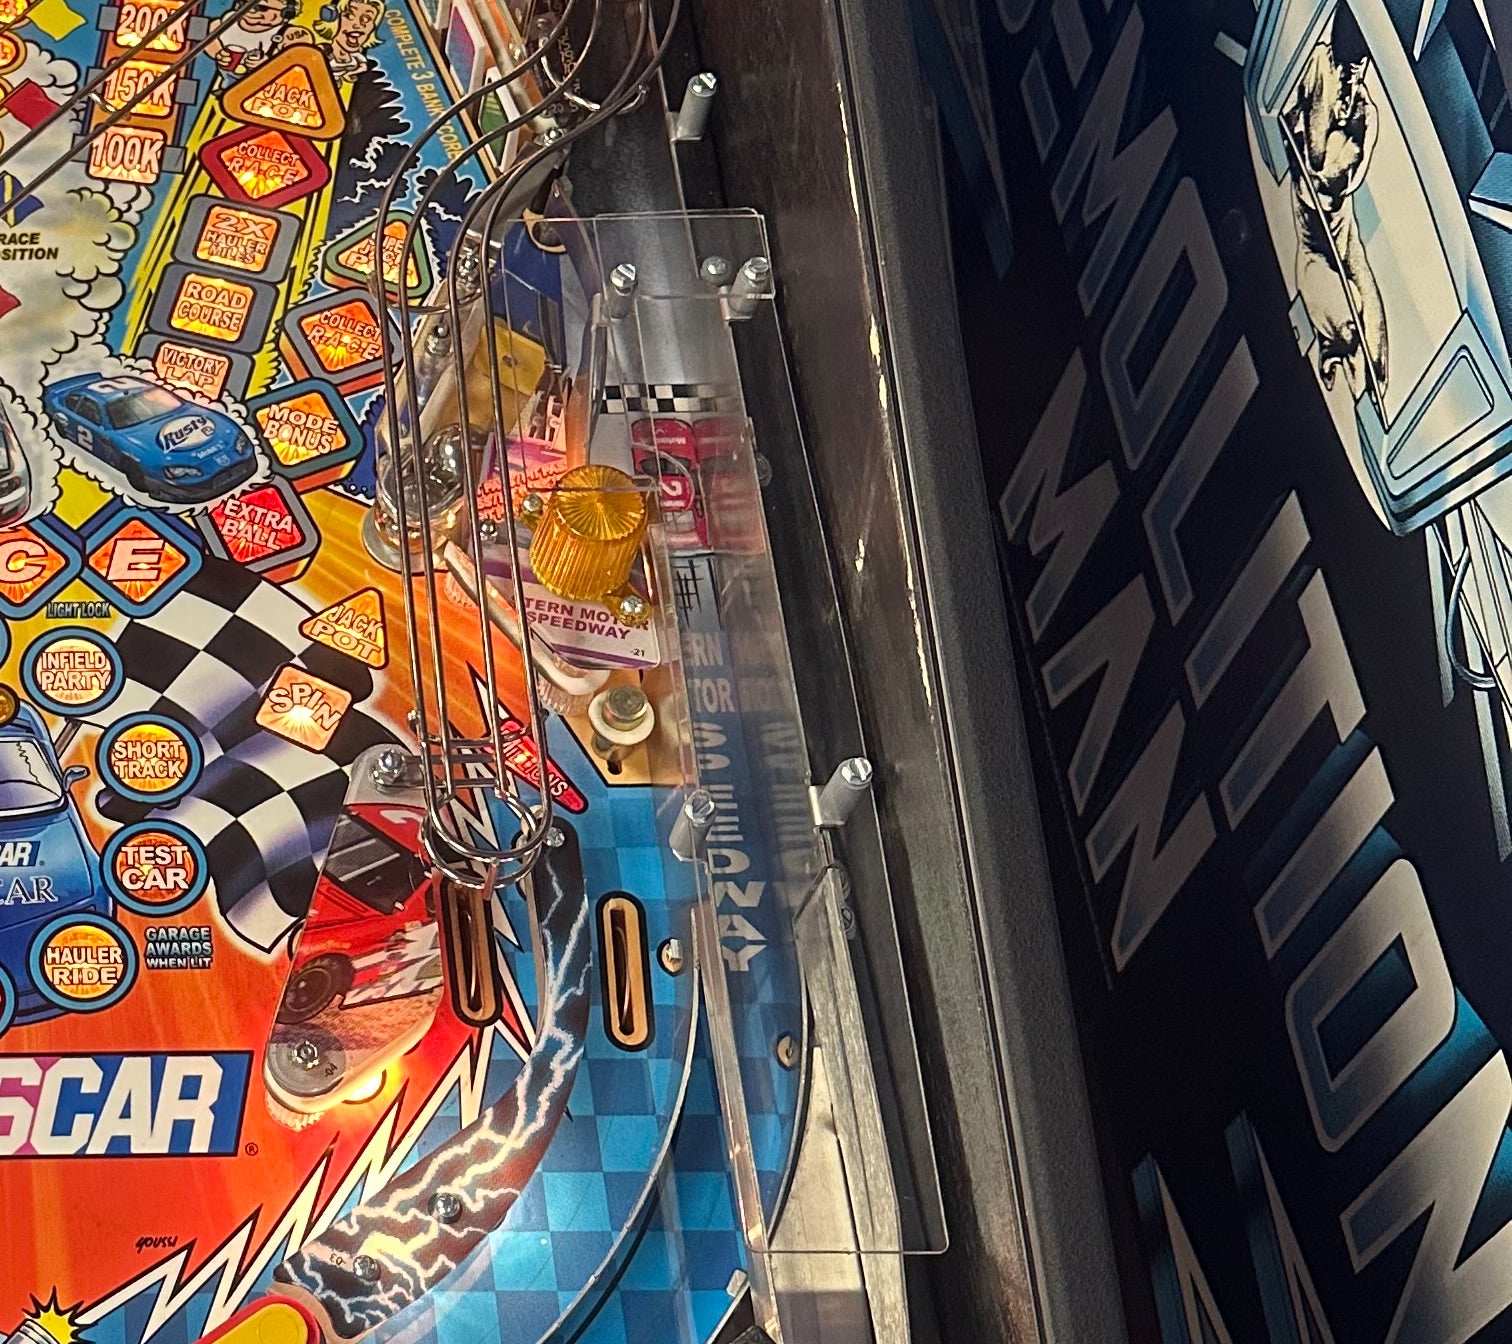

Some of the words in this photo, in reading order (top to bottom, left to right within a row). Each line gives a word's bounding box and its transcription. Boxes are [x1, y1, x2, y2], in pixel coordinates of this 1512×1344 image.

[89, 132, 162, 175] 100K
[186, 283, 248, 310] ROAD
[177, 301, 245, 332] COURSE
[159, 348, 226, 375] VICTORY
[268, 404, 338, 433] MODE
[162, 413, 209, 452] Rusty
[264, 421, 335, 455] BONUS
[223, 498, 294, 533] EXTRA
[222, 517, 284, 551] BALL
[46, 603, 76, 619] LIGHT
[76, 602, 111, 618] LOCK
[41, 651, 108, 671] INFIELD
[999, 346, 1219, 974] MAN
[41, 671, 111, 692] PARTY
[268, 680, 343, 732] SPIN
[113, 739, 184, 760] SHORT
[115, 758, 186, 780] TRACK
[121, 845, 189, 865] TEST
[121, 868, 190, 890] CAR
[45, 946, 123, 966] HAULER
[51, 966, 119, 986] RIDE
